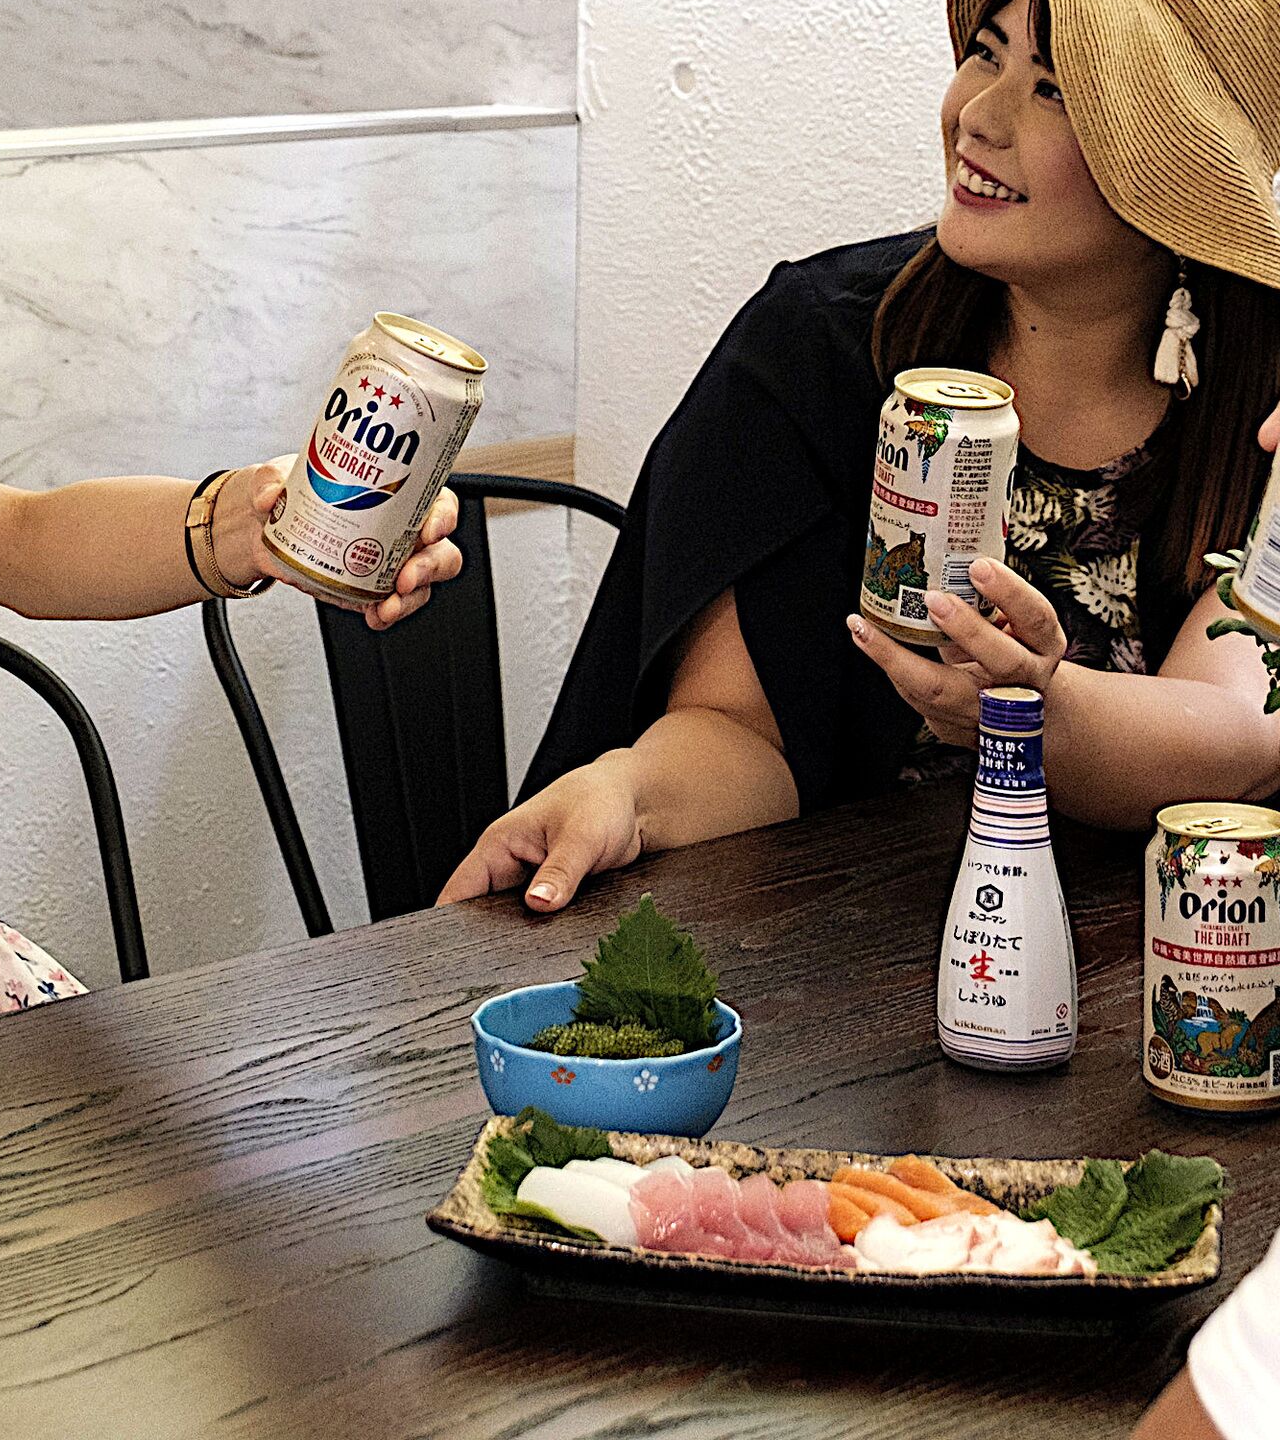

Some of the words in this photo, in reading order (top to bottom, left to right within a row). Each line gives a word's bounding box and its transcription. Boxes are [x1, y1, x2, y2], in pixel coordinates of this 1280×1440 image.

[324, 387, 421, 466] Orion
[319, 436, 342, 464] THE
[337, 450, 385, 486] DRAFT
[359, 447, 380, 464] CRAFT
[968, 911, 1007, 925] キッコーマン
[1179, 889, 1266, 924] Orion
[953, 924, 1023, 951] しぼりたて
[1194, 930, 1214, 945] THE
[1216, 932, 1251, 947] DRAFT
[968, 949, 997, 983] 生
[958, 987, 1007, 1008] しょうゆ
[953, 1018, 1007, 1036] kikkoman
